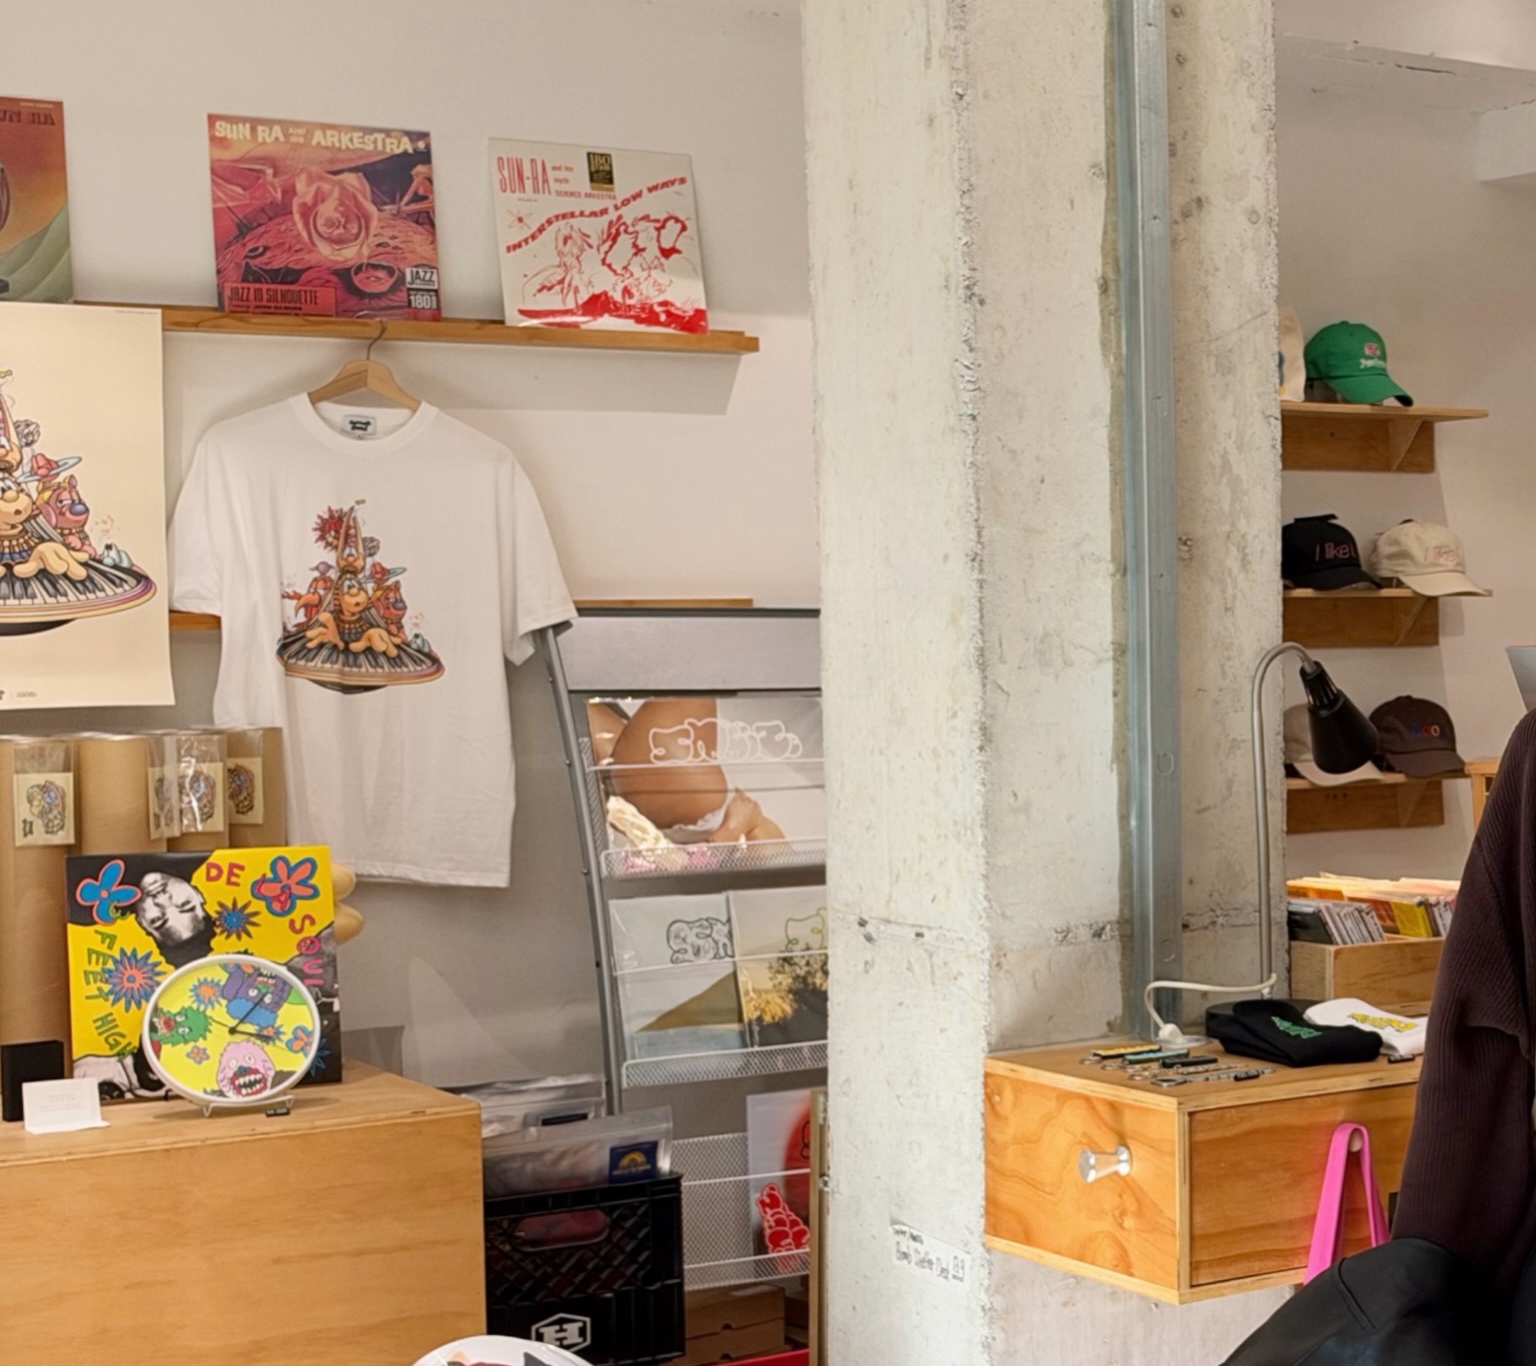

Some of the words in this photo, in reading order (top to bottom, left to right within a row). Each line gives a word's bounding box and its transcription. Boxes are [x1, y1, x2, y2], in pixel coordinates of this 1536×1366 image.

[215, 121, 250, 139] SUN
[257, 125, 284, 143] RA
[312, 130, 413, 154] ARKESTRA
[497, 156, 551, 196] SUN-RA
[506, 208, 609, 254] INTERSTELLAR
[613, 190, 643, 212] LOW
[647, 176, 687, 195] WAYS
[228, 286, 250, 302] JAZZ
[266, 289, 318, 305] SILHOUETTE
[408, 270, 435, 286] JAZZ
[205, 862, 246, 887] DE
[83, 929, 120, 1002] FEET
[92, 1012, 138, 1063] HIGH
